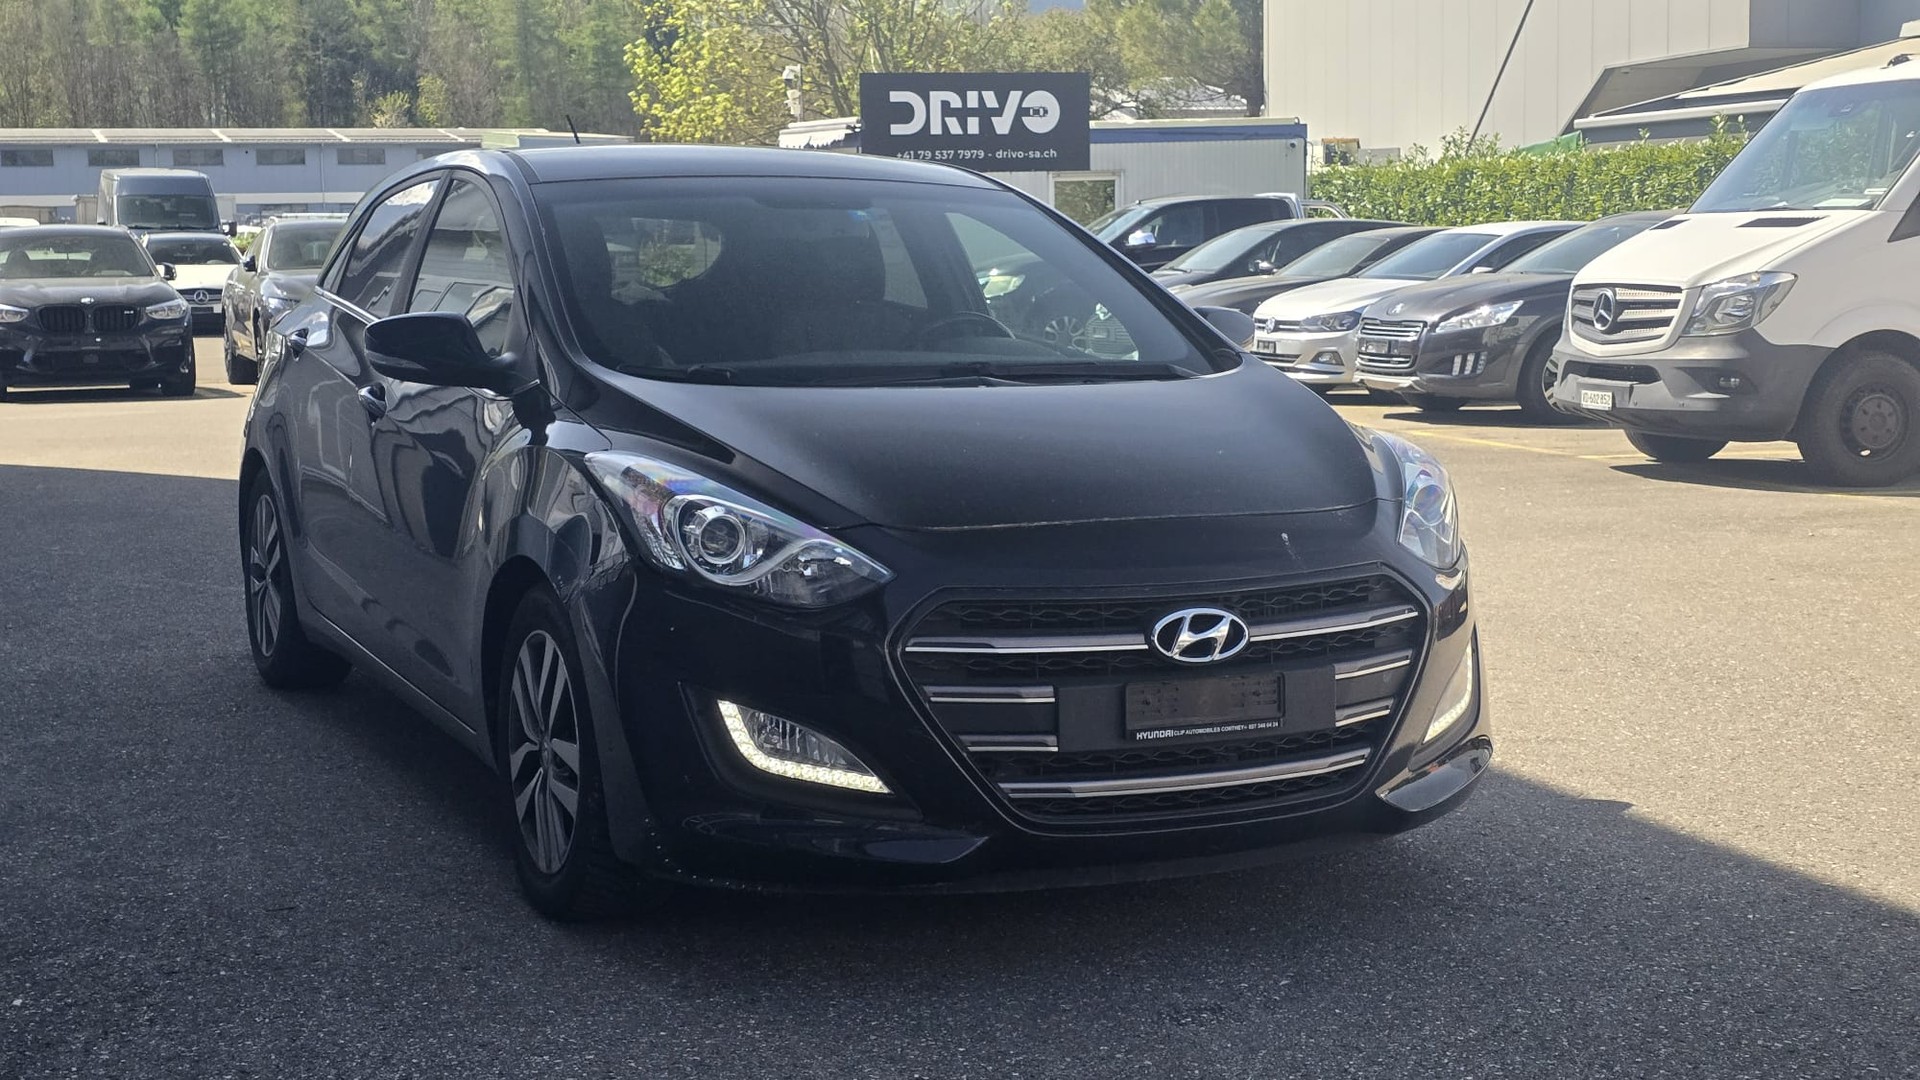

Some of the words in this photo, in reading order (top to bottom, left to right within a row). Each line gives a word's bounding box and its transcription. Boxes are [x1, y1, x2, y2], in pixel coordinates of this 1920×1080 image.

[889, 90, 1061, 135] DRIVO
[917, 150, 932, 160] 79
[935, 149, 955, 160] 537
[957, 149, 985, 159] 7979
[995, 148, 1058, 159] drivo-sa.ch
[1136, 729, 1174, 741] HYUNDAI
[1185, 726, 1221, 736] AUTOMOBILES
